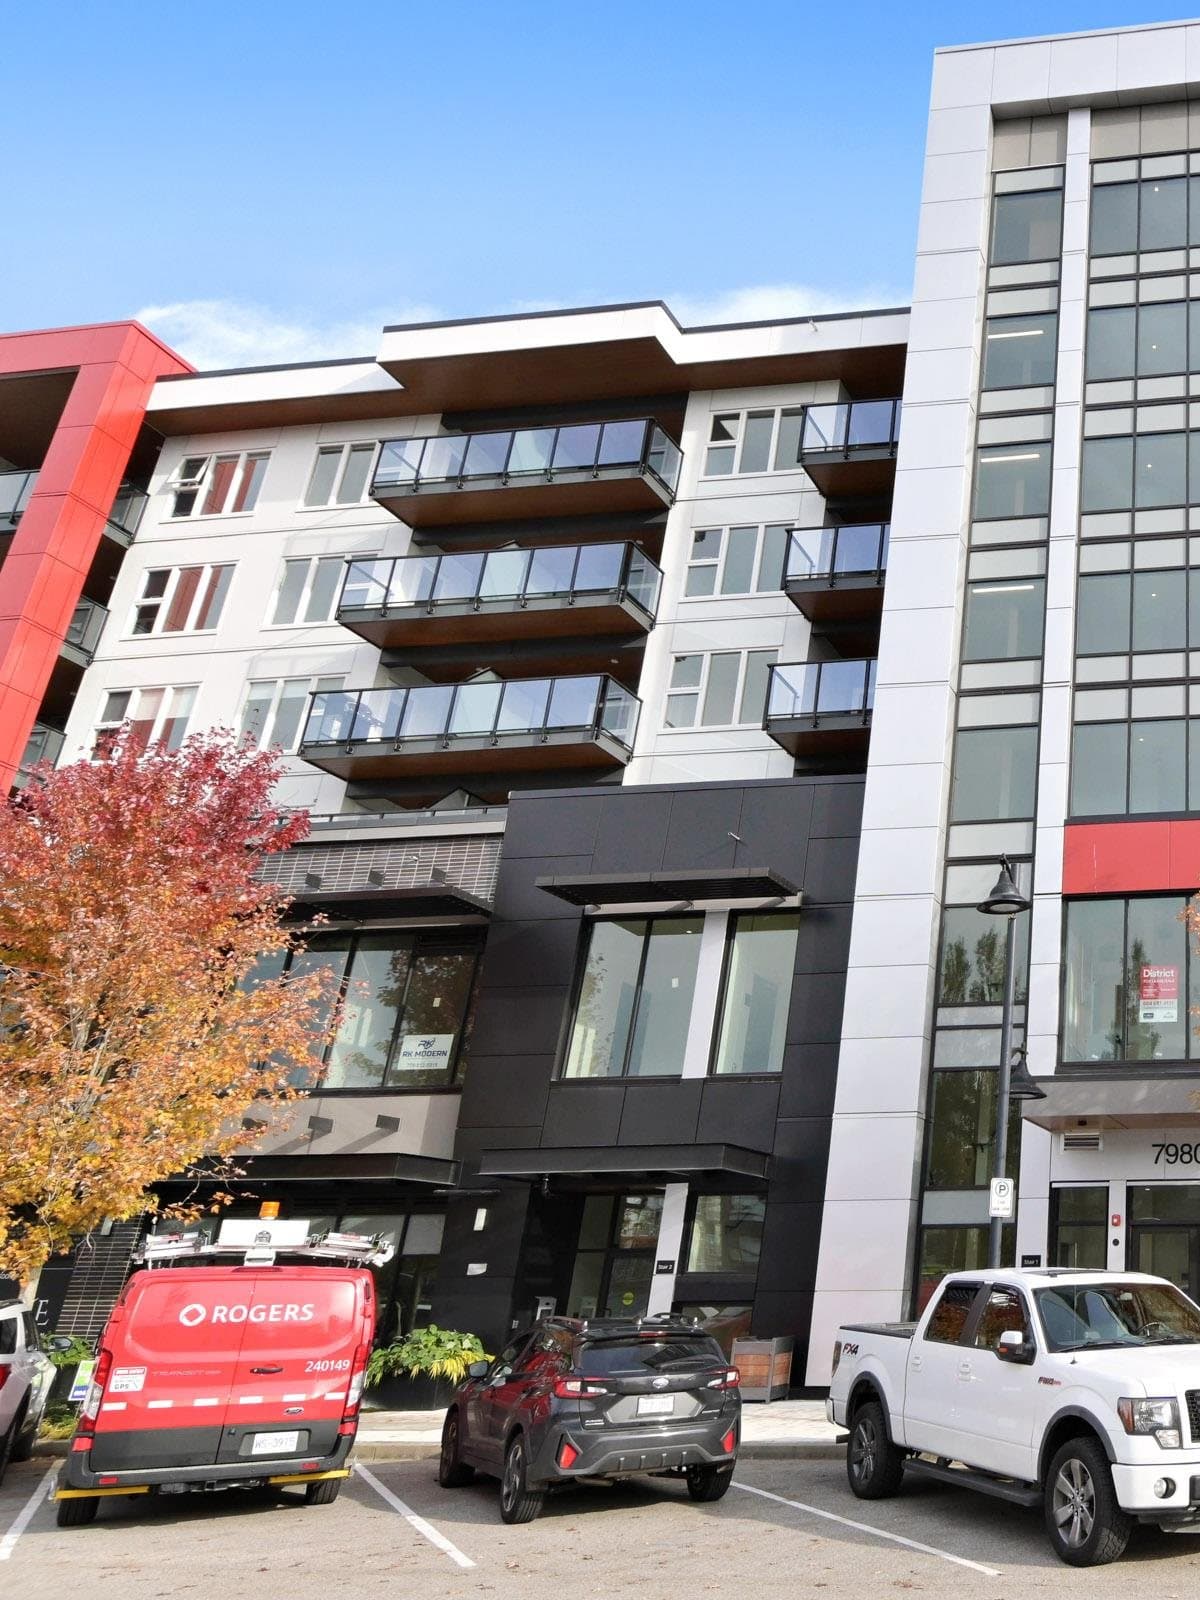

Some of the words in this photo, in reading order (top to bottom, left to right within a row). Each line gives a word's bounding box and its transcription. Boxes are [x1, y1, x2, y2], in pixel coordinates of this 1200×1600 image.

[1143, 968, 1174, 978] District
[414, 1050, 448, 1058] MODERN
[211, 1303, 315, 1324] ROGERS
[842, 1343, 859, 1356] FX4
[304, 1359, 351, 1373] 240149
